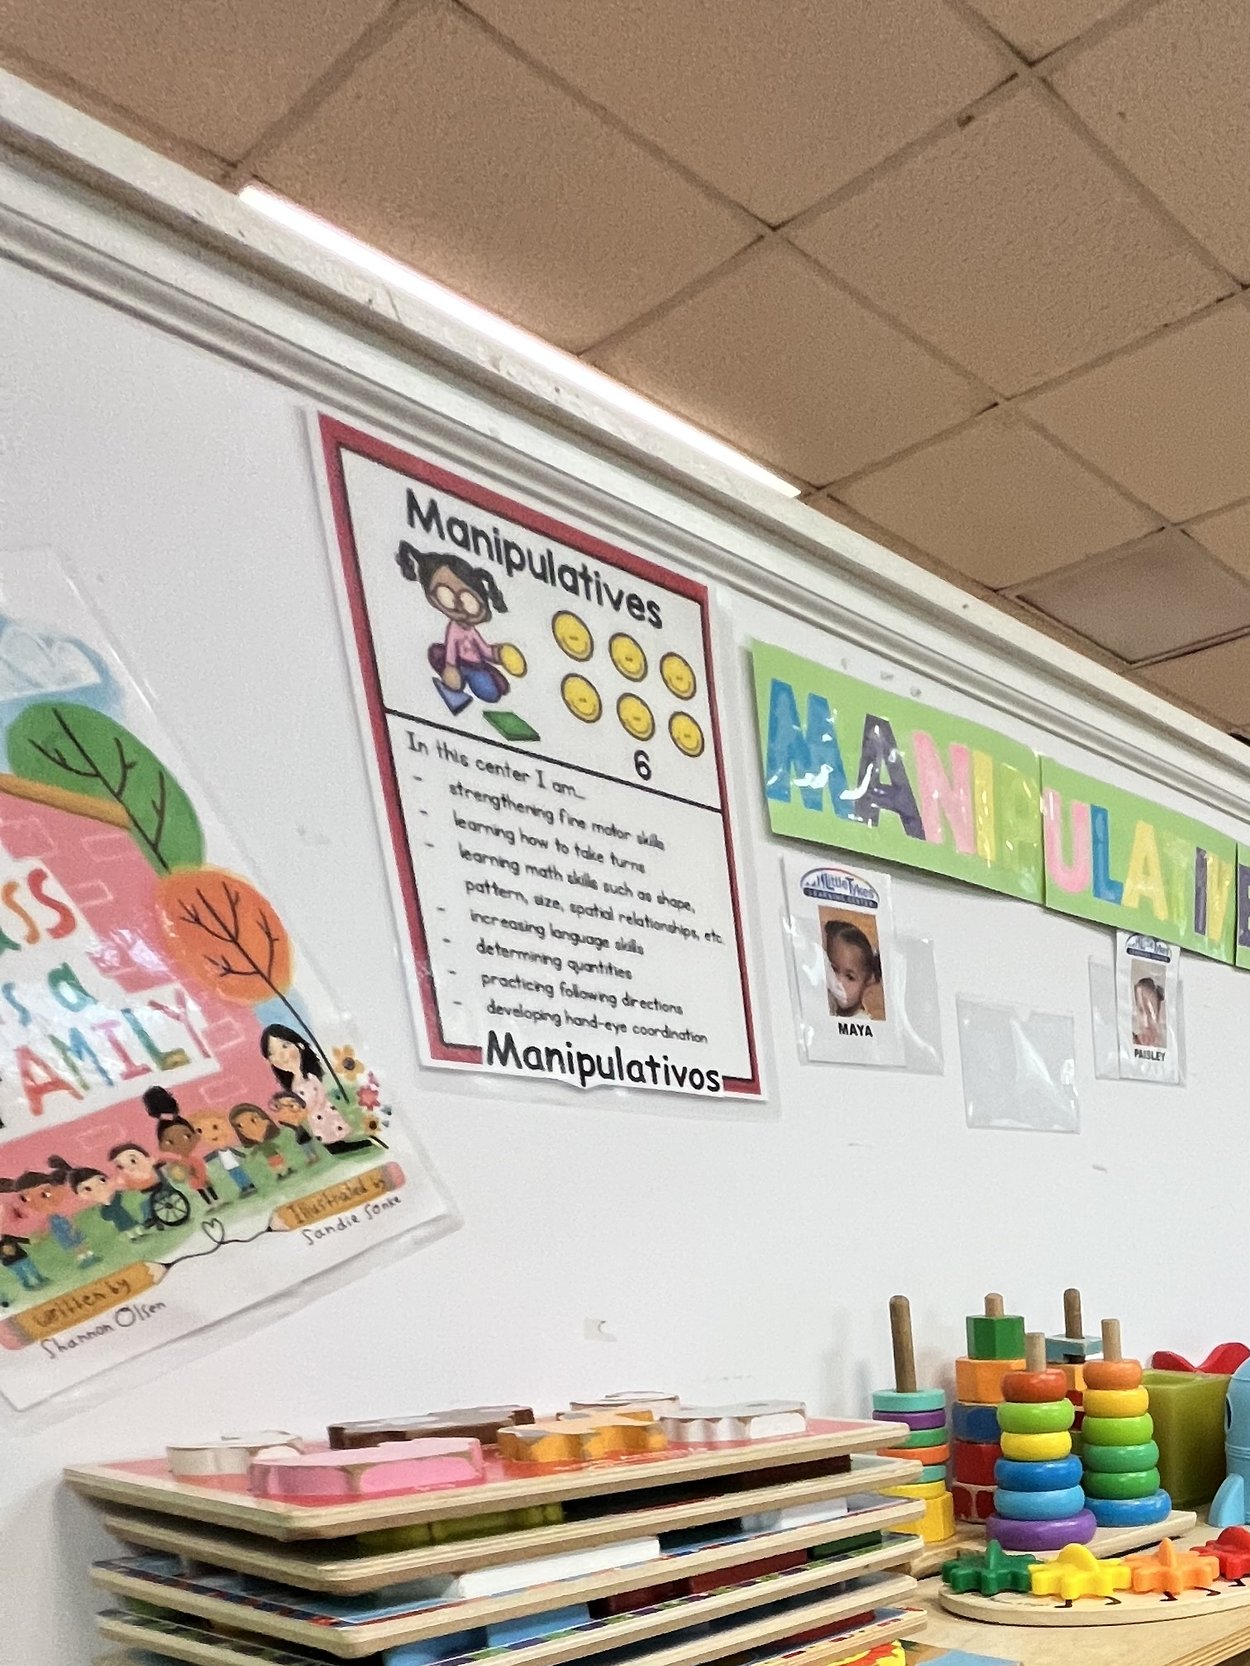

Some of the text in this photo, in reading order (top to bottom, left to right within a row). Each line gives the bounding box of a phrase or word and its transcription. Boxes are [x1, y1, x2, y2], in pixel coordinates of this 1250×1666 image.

[406, 487, 663, 629] Manipulatives
[406, 730, 429, 755] In
[436, 740, 469, 767] this
[475, 759, 531, 782] center
[535, 769, 546, 789] I
[633, 749, 651, 780] 6
[449, 780, 665, 851] strengthening fine motor skills
[452, 809, 645, 874] learning how to take turns
[458, 842, 520, 876] learning
[525, 863, 563, 882] math
[567, 870, 599, 891] skills
[603, 881, 634, 897] such
[637, 890, 652, 903] as
[0, 868, 77, 952] SS
[464, 879, 528, 905] pattern,
[533, 894, 564, 912] size,
[569, 902, 614, 921] spatial
[470, 909, 644, 956] increasing language skills
[476, 937, 632, 980] determining quantities
[48, 962, 98, 1012] a
[481, 974, 683, 1015] practicing following directions
[487, 999, 708, 1044] developing hand-eye coordination
[838, 1022, 873, 1037] MAYA
[0, 988, 211, 1128] AMILY
[487, 1030, 721, 1092] Manipulativos
[301, 1214, 361, 1246] Sandie
[104, 1279, 132, 1297] by
[40, 1301, 167, 1359] Shannon Olsen
